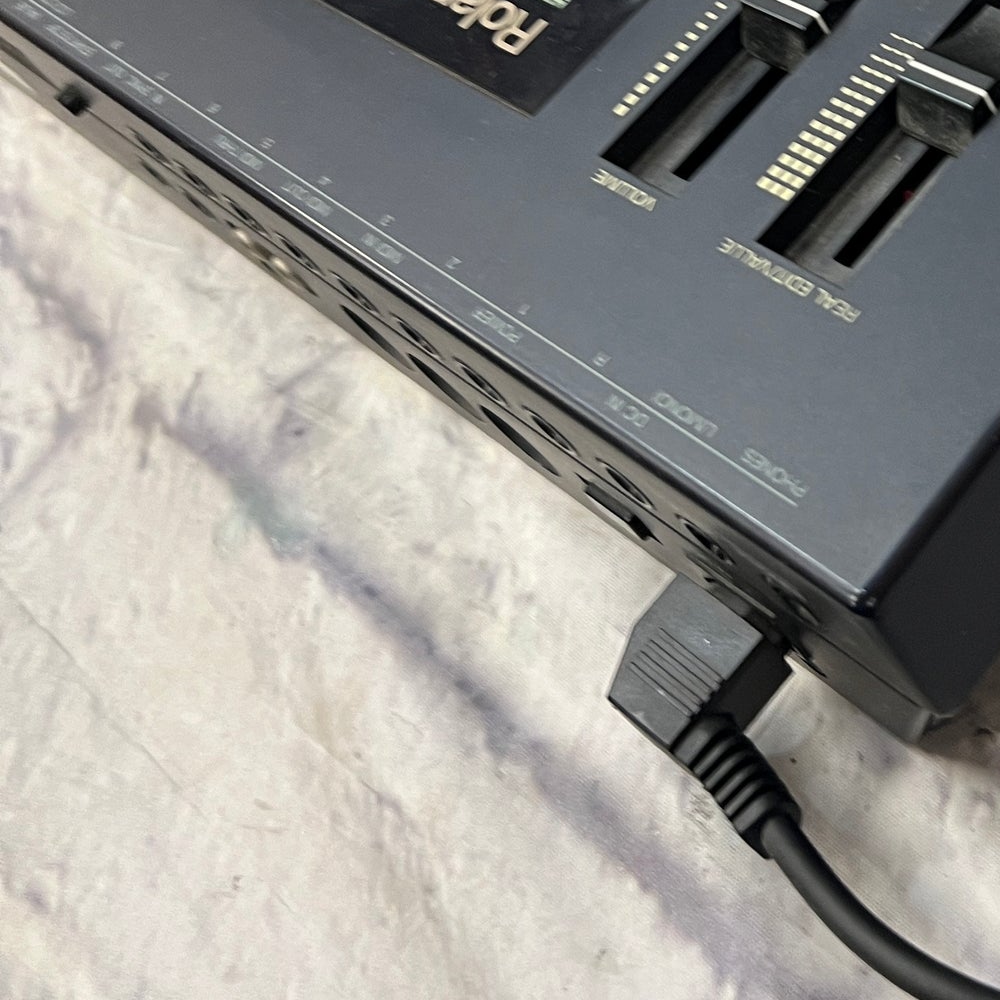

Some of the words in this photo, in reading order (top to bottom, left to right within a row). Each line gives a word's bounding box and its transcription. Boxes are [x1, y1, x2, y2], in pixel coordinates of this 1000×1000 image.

[590, 168, 657, 212] VOLUME
[716, 236, 815, 297] EDIT/VALUE
[814, 287, 862, 323] REAL
[471, 308, 522, 344] POWER
[603, 393, 626, 413] IN
[621, 405, 651, 428] DC
[739, 447, 810, 498] PHONES
